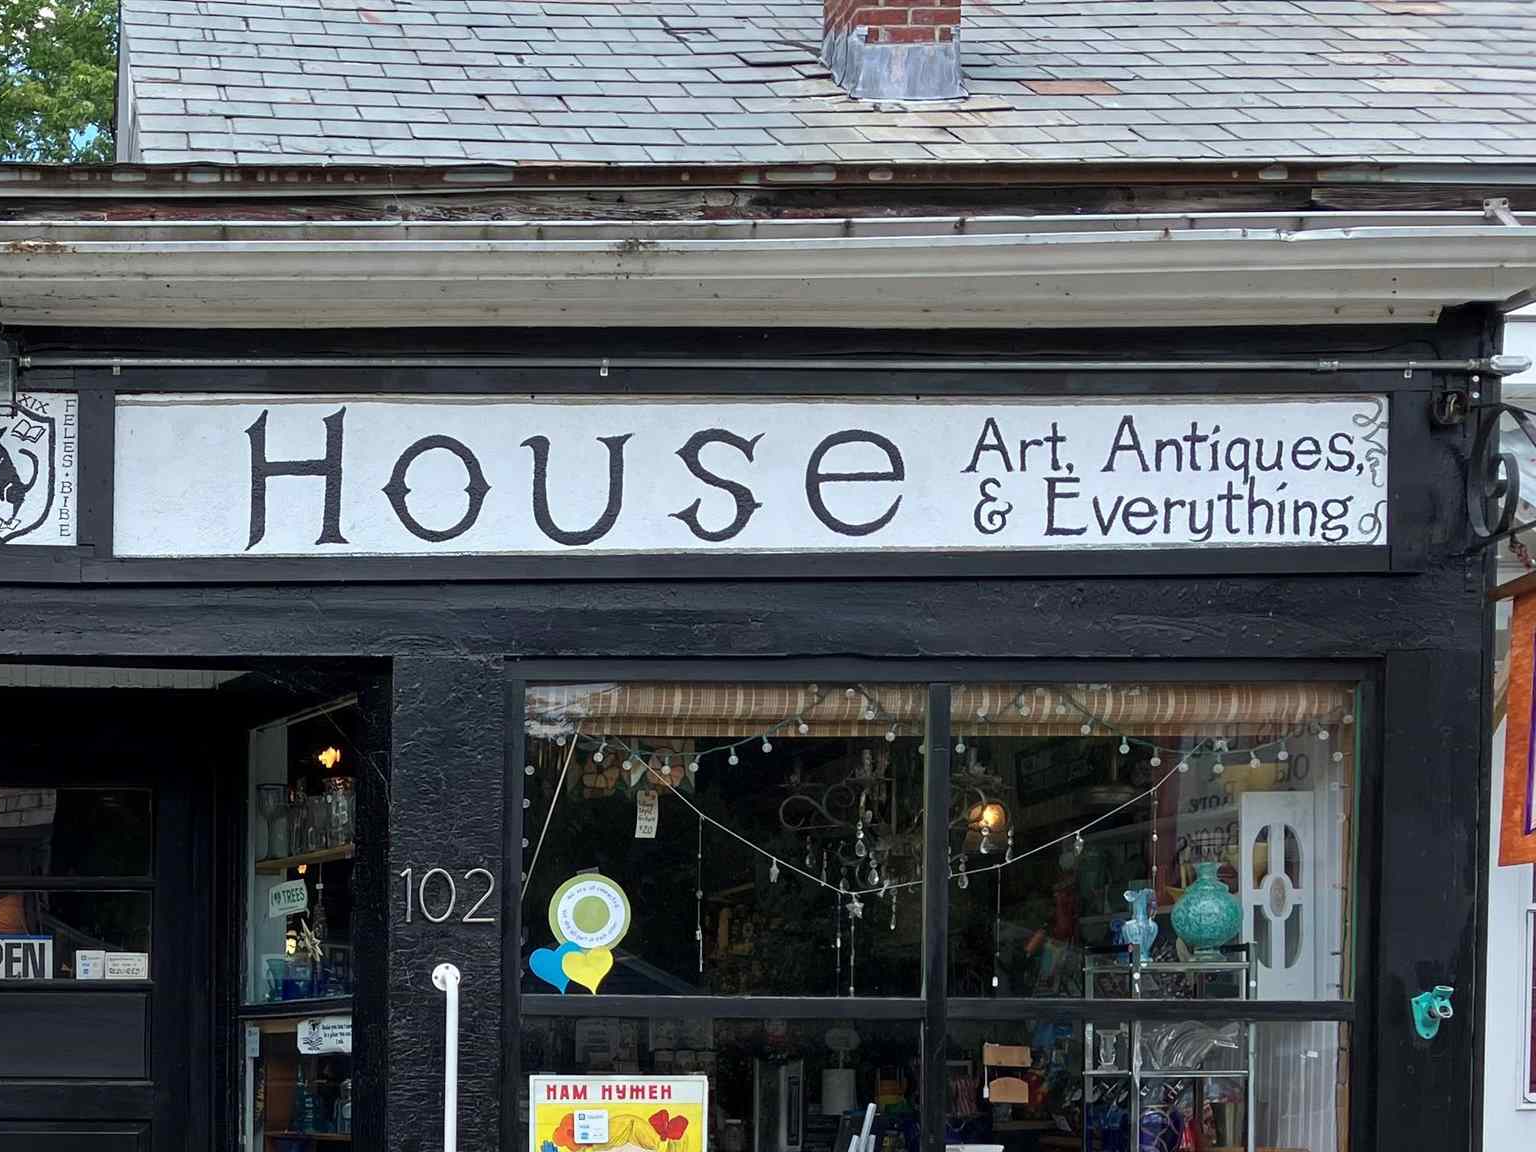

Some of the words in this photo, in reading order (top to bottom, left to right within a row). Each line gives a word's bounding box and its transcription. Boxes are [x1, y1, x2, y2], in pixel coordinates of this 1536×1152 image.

[973, 477, 1013, 535] &
[1043, 476, 1354, 543] Everything
[399, 868, 495, 923] 102
